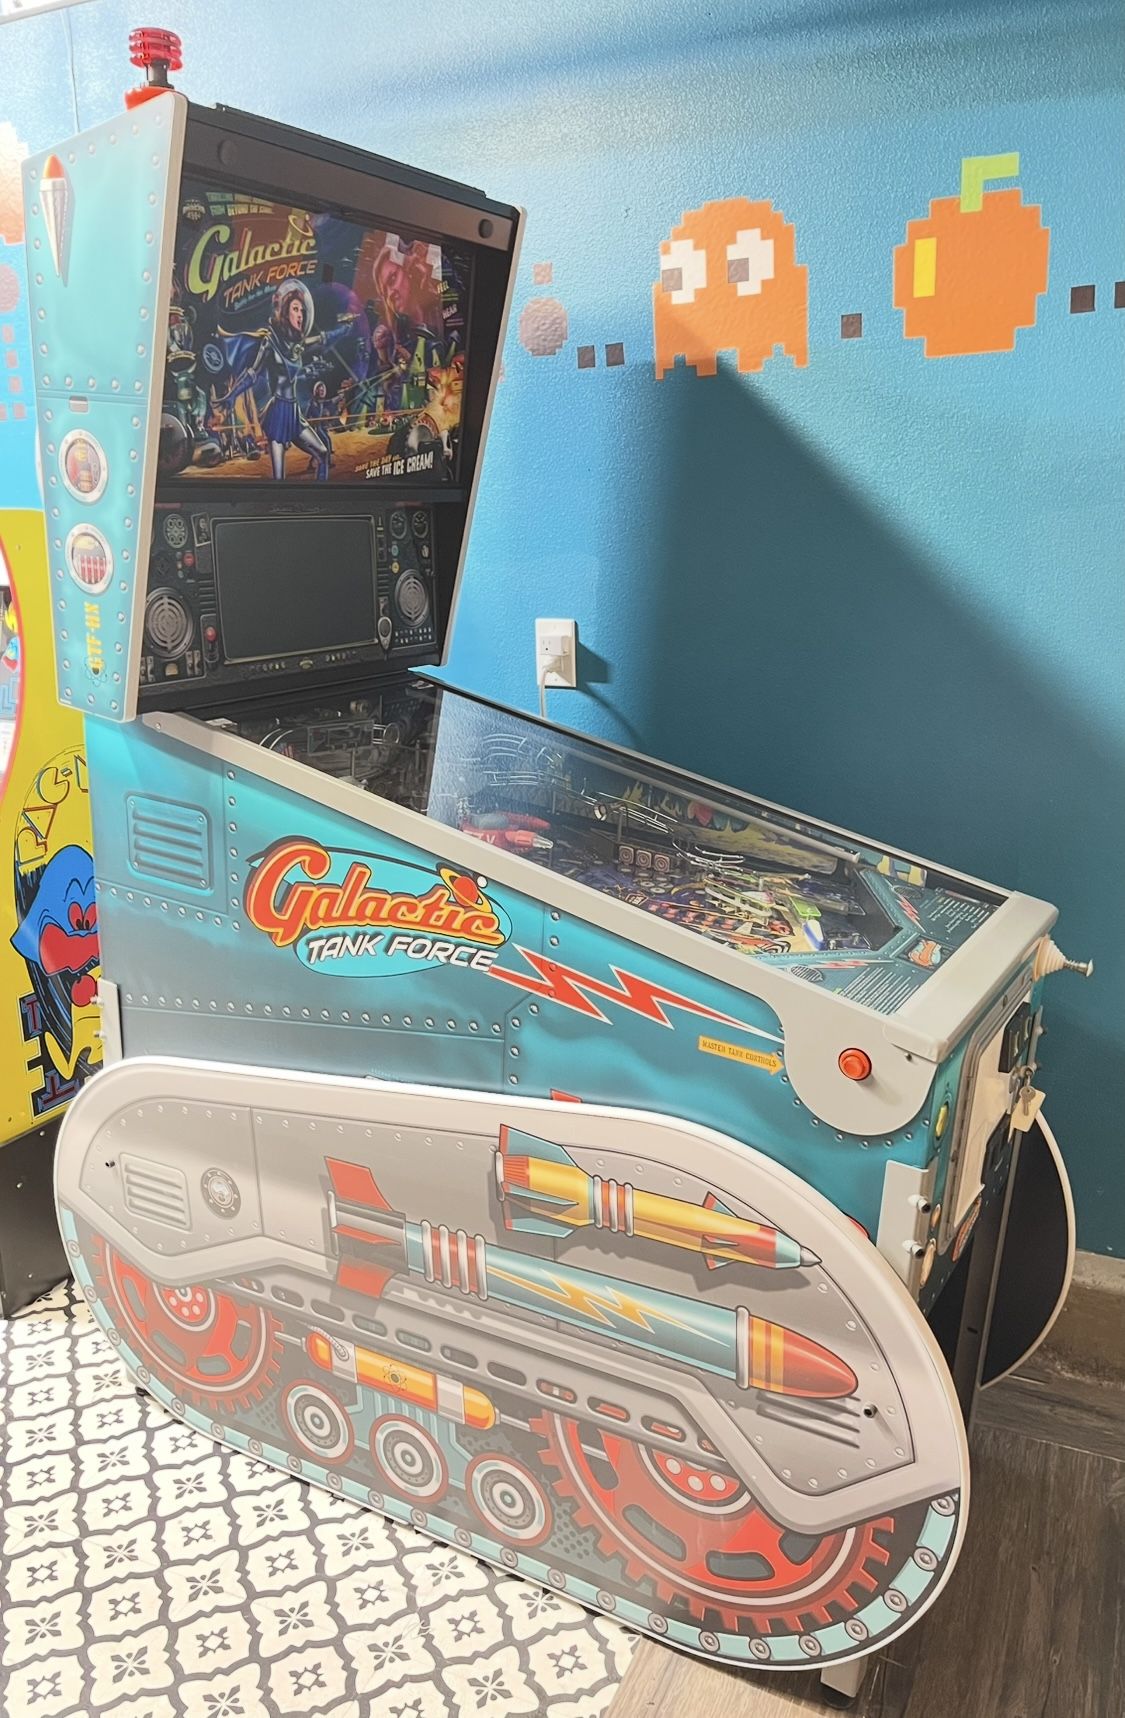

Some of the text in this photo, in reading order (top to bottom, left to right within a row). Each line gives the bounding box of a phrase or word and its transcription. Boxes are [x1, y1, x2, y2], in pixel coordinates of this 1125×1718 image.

[188, 224, 318, 301] Galactic
[224, 271, 264, 308] TANK
[266, 260, 318, 283] FORCE
[366, 451, 434, 479] SAVE THE ICE CREAM!
[246, 838, 505, 948] Galactic
[308, 934, 498, 971] TANK FORCE
[702, 1040, 777, 1068] MASTER TANK CONTROLS
